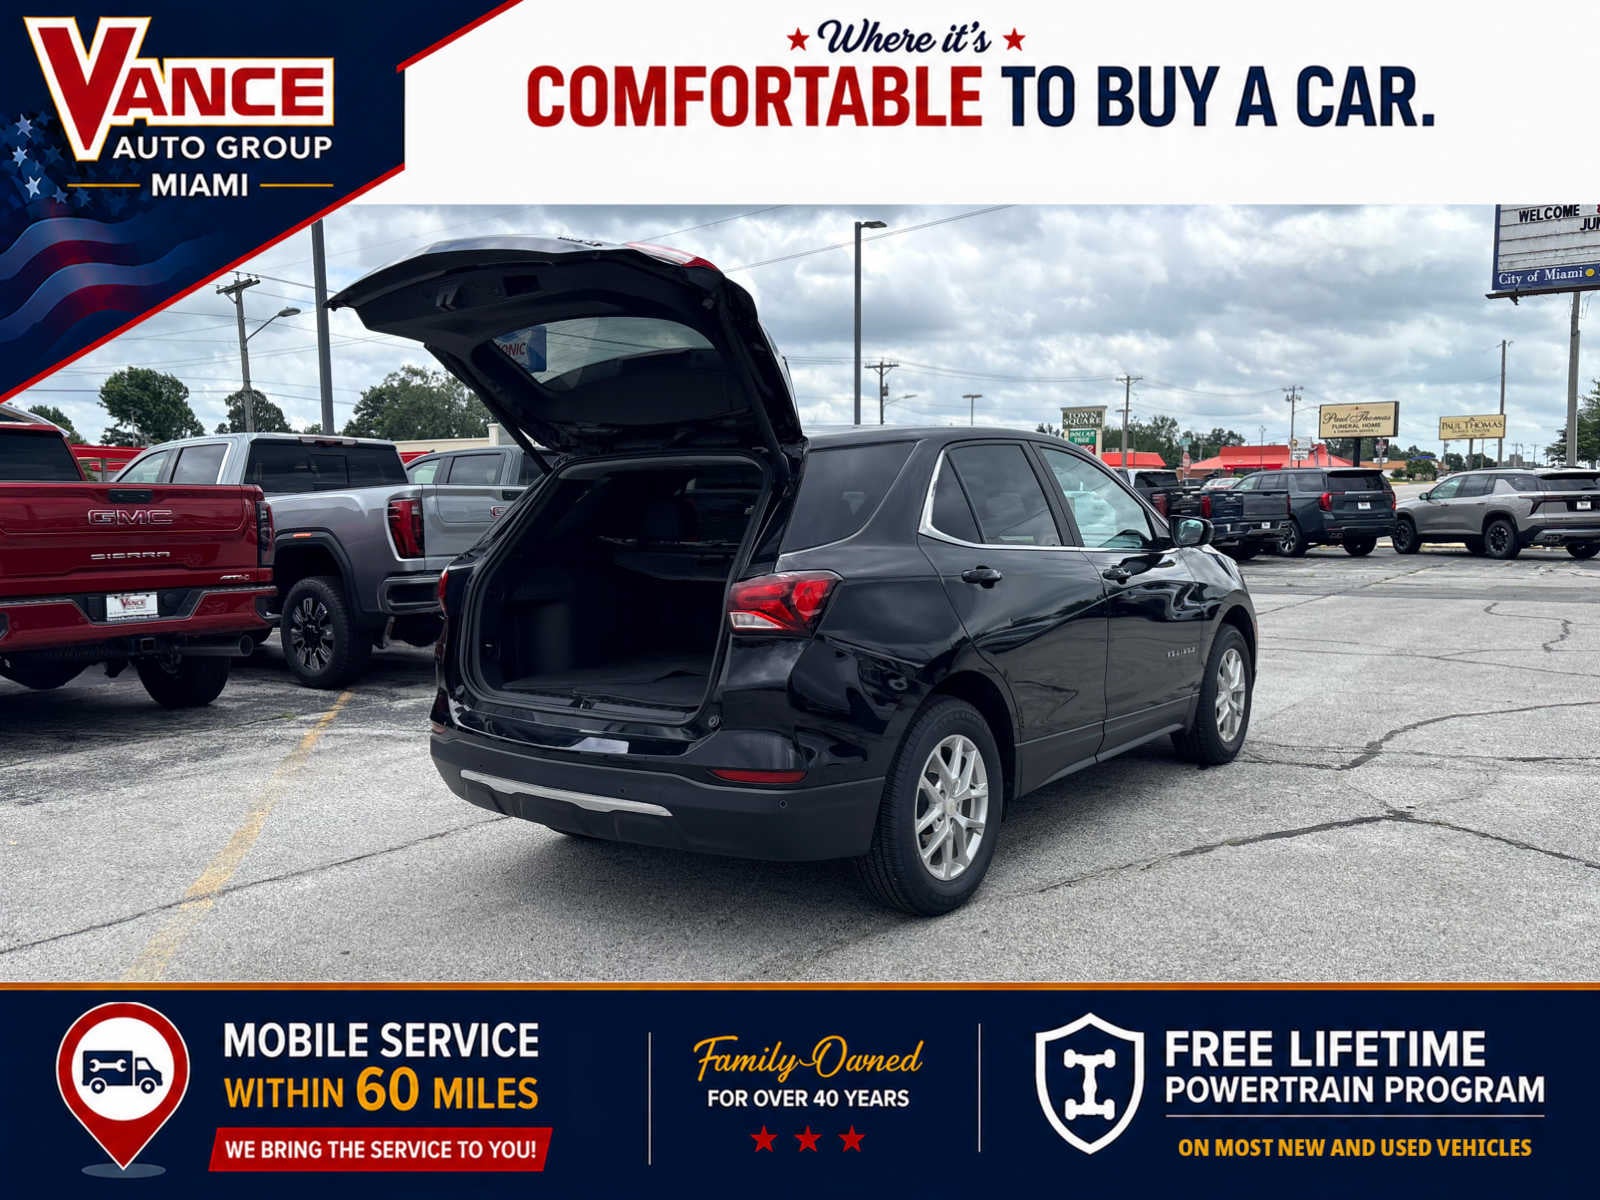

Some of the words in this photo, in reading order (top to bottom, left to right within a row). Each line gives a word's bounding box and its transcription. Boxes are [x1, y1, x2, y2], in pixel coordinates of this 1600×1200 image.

[1519, 204, 1580, 222] WELCOME
[1499, 273, 1522, 287] City
[1527, 270, 1540, 282] of
[1544, 266, 1584, 281] Miami
[1068, 411, 1097, 419] TOWN
[1322, 411, 1349, 424] Paul
[1350, 411, 1392, 423] Thomas
[1063, 417, 1102, 426] SQUARE
[1362, 421, 1382, 429] HOME
[1442, 421, 1462, 430] PAUL
[1464, 419, 1503, 429] THOMAS
[1070, 430, 1096, 438] DOLLAR
[88, 508, 173, 526] GMC
[91, 551, 171, 560] SIERRA
